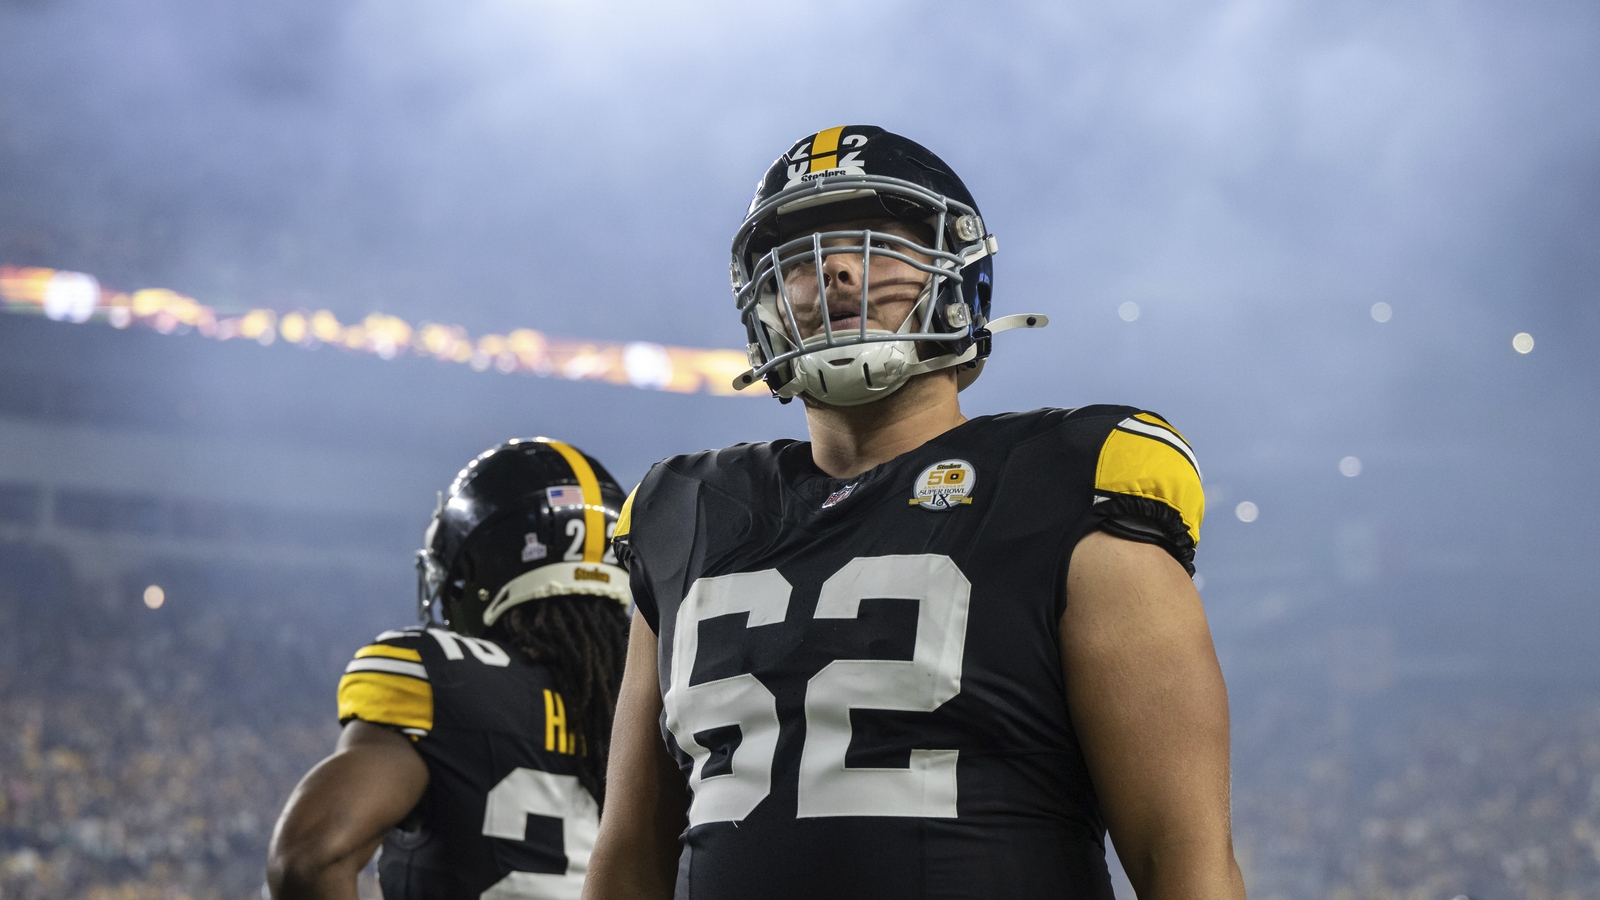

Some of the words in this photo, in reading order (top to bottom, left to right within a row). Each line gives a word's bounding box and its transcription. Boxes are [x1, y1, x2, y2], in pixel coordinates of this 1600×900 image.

[927, 469, 966, 485] 50
[931, 494, 952, 508] IX
[664, 553, 971, 828] 62
